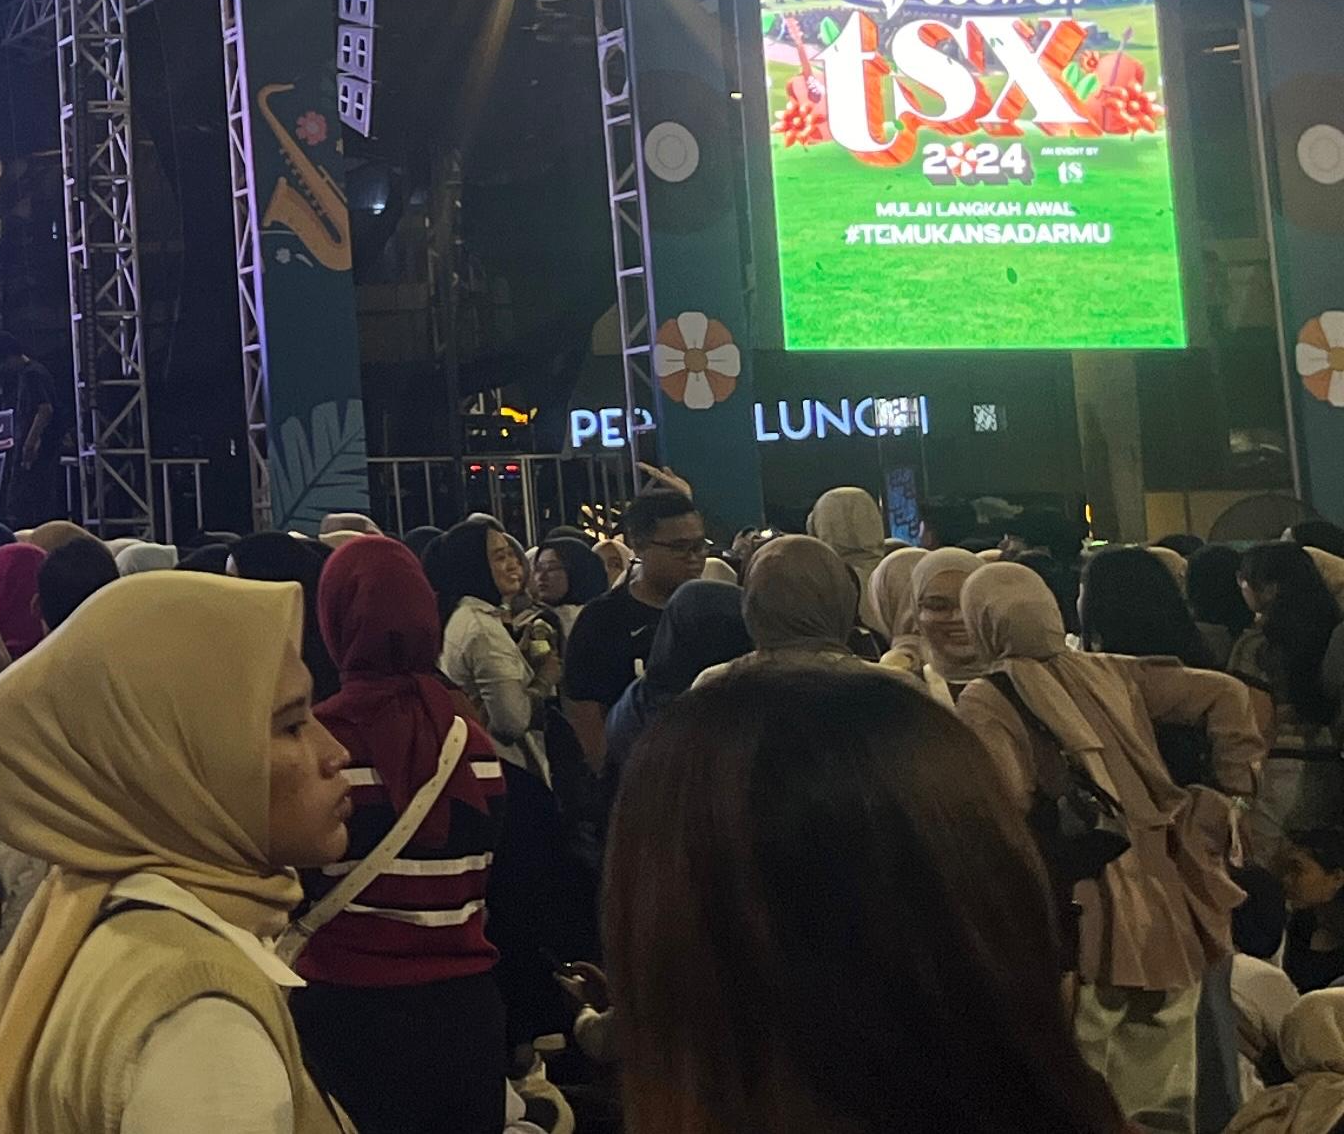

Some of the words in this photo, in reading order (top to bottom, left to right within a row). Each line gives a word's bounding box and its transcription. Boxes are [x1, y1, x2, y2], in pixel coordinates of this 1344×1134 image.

[875, 202, 932, 217] MULAI
[936, 202, 1021, 217] LANGKAH
[1024, 201, 1076, 216] AWAL
[844, 223, 1111, 244] #TEMUKANSADARMU
